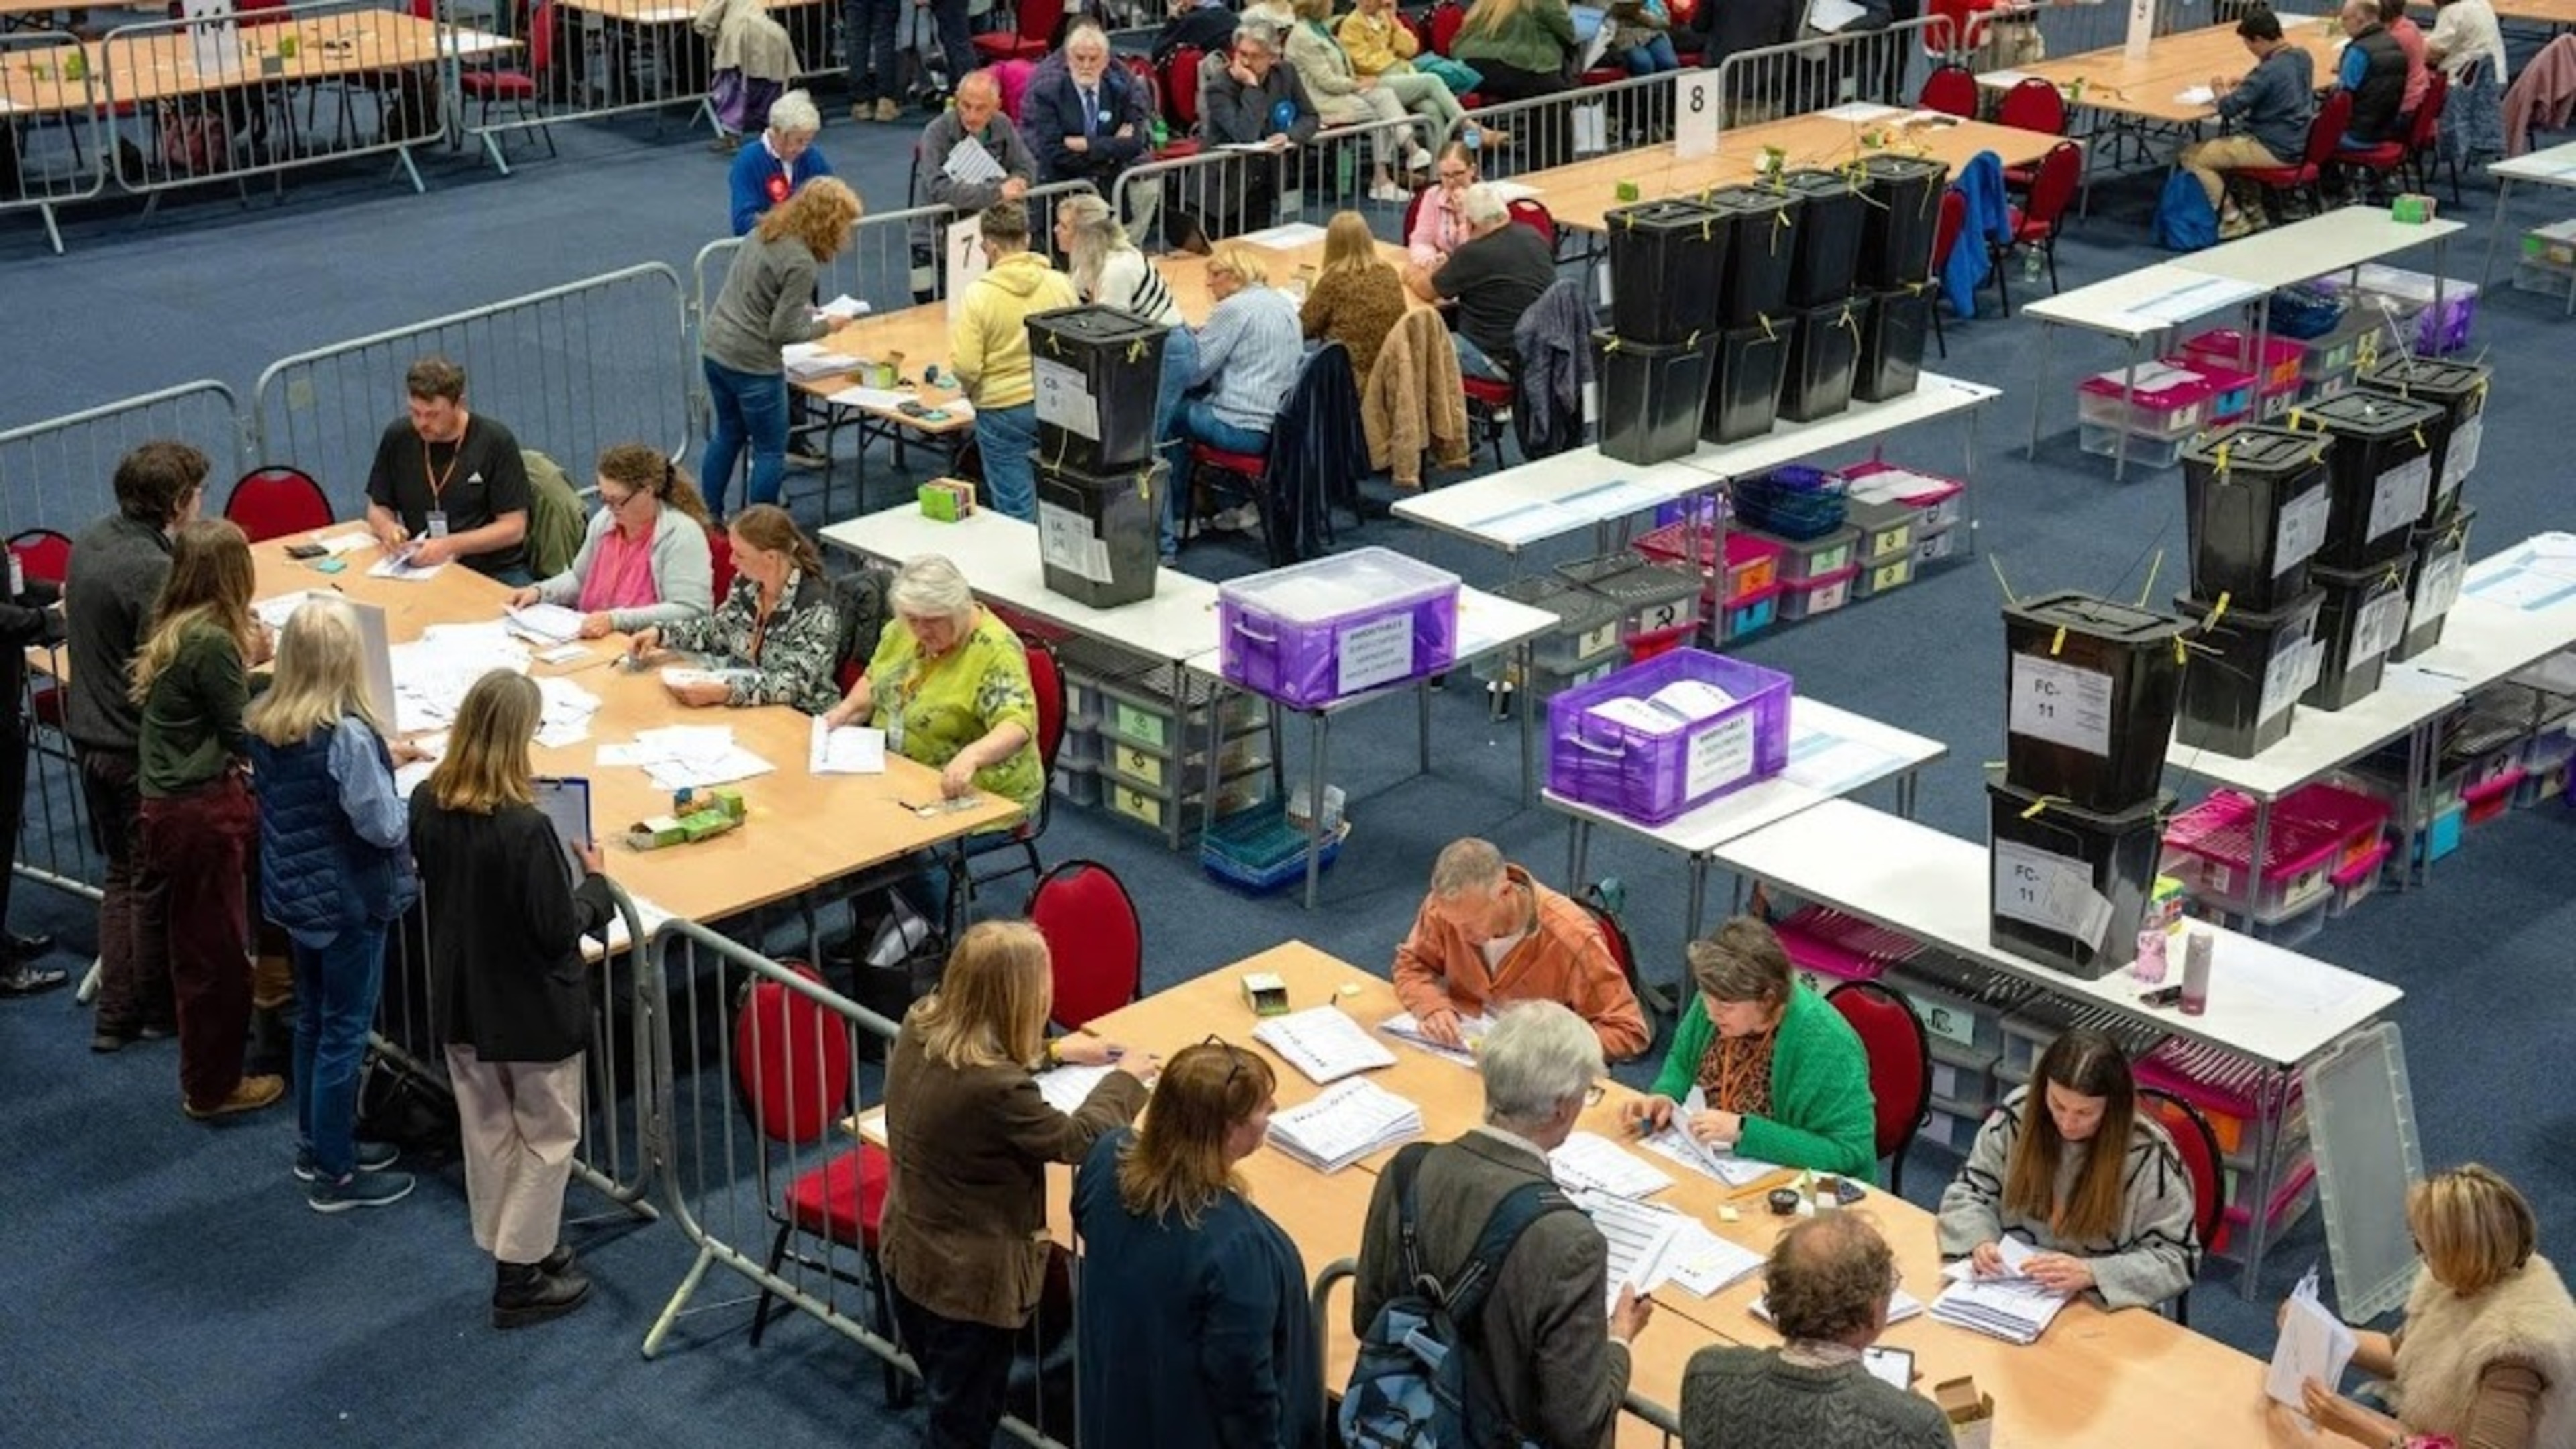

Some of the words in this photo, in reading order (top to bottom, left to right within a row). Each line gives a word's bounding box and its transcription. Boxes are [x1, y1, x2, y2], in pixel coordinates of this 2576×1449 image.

[1690, 85, 1704, 113] 8
[961, 233, 974, 269] 7
[2034, 678, 2061, 696] FC-
[2038, 703, 2054, 718] 11
[2015, 865, 2040, 881] FC-
[2019, 888, 2034, 902] 11
